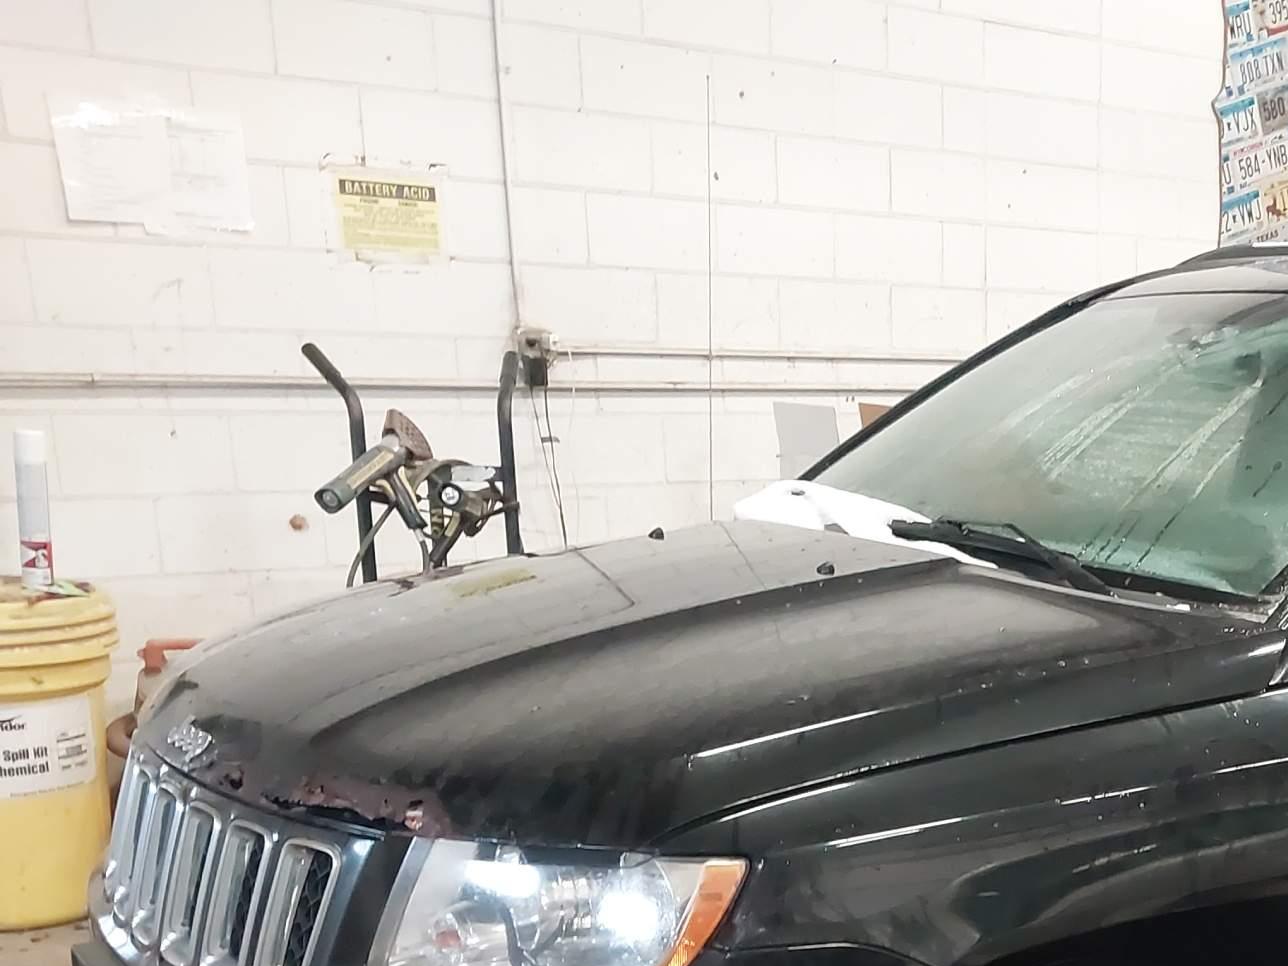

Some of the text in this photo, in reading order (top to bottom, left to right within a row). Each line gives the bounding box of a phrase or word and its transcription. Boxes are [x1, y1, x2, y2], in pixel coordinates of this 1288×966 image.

[344, 180, 430, 201] BATTERY ACID
[2, 746, 48, 763] Spill Kit
